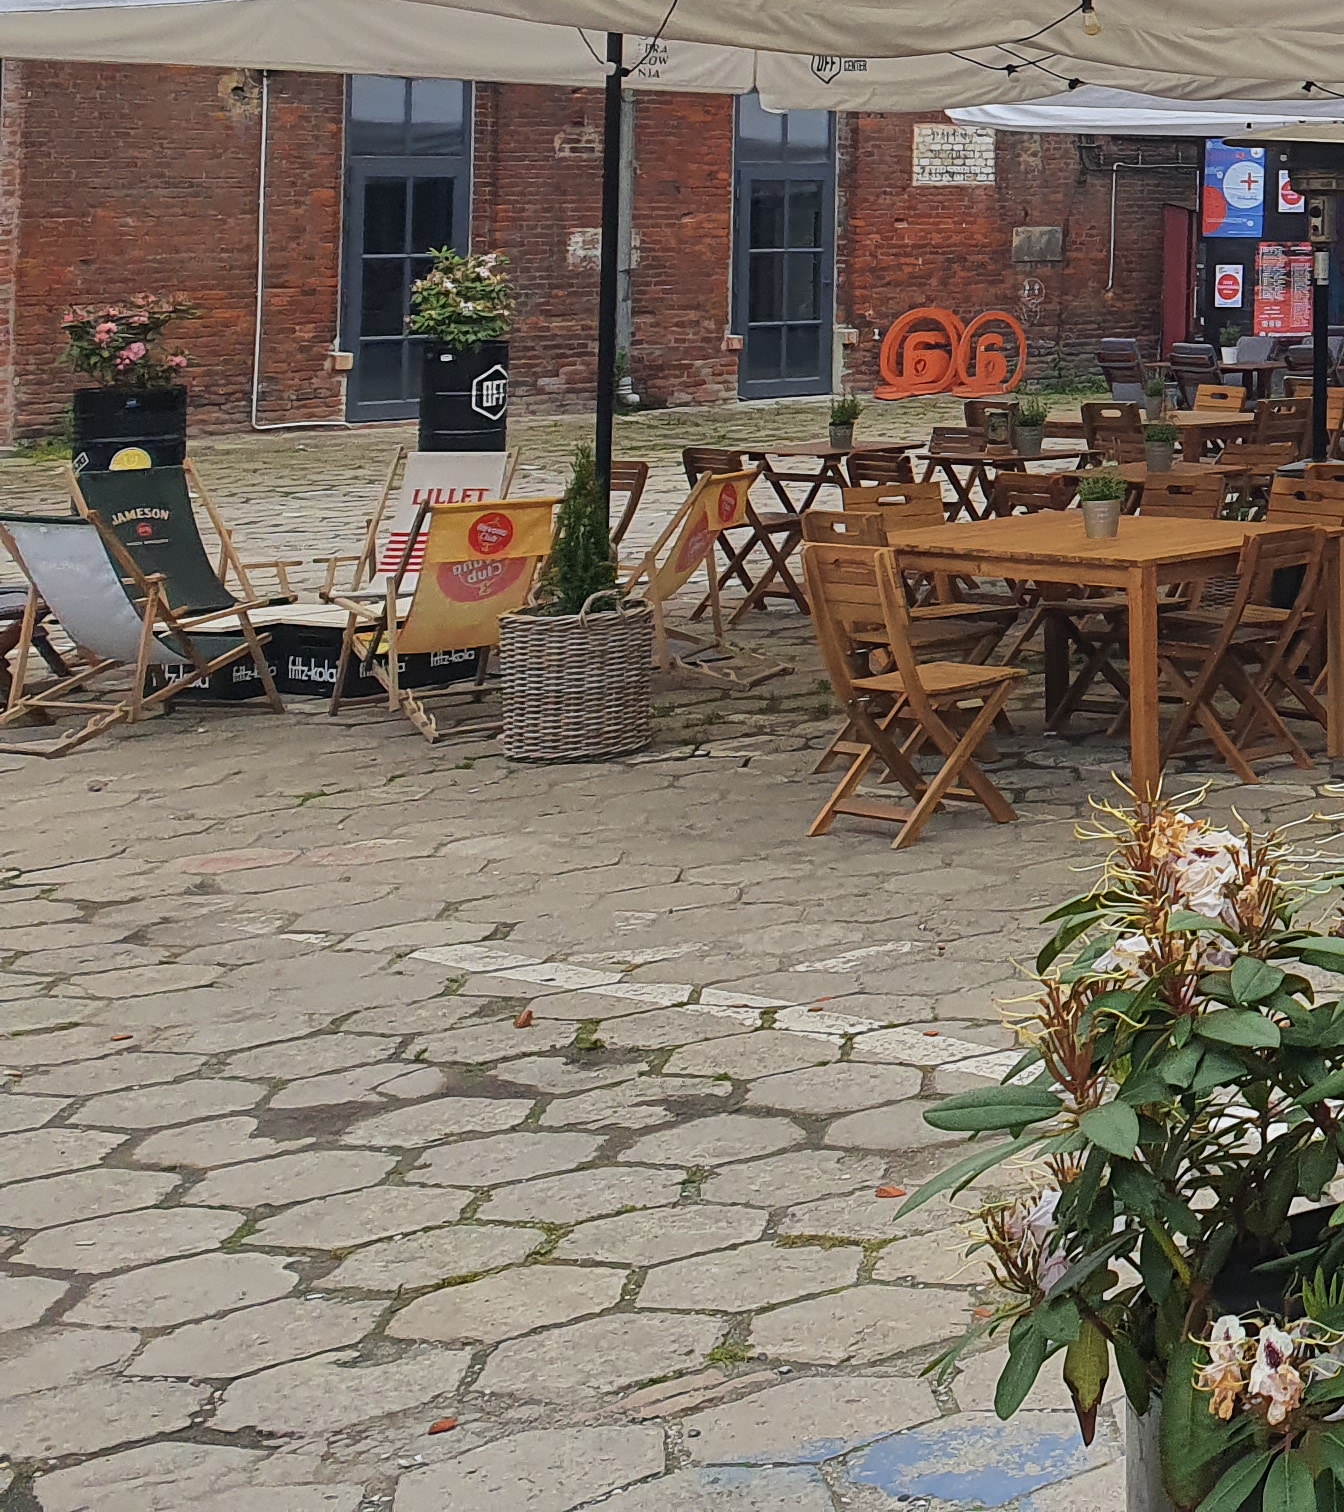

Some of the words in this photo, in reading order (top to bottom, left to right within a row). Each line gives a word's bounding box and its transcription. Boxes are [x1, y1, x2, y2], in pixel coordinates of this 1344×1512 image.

[482, 380, 507, 407] OFF
[411, 487, 491, 505] LILLET
[111, 507, 170, 526] JAMESON
[288, 655, 337, 683] fritz-kola
